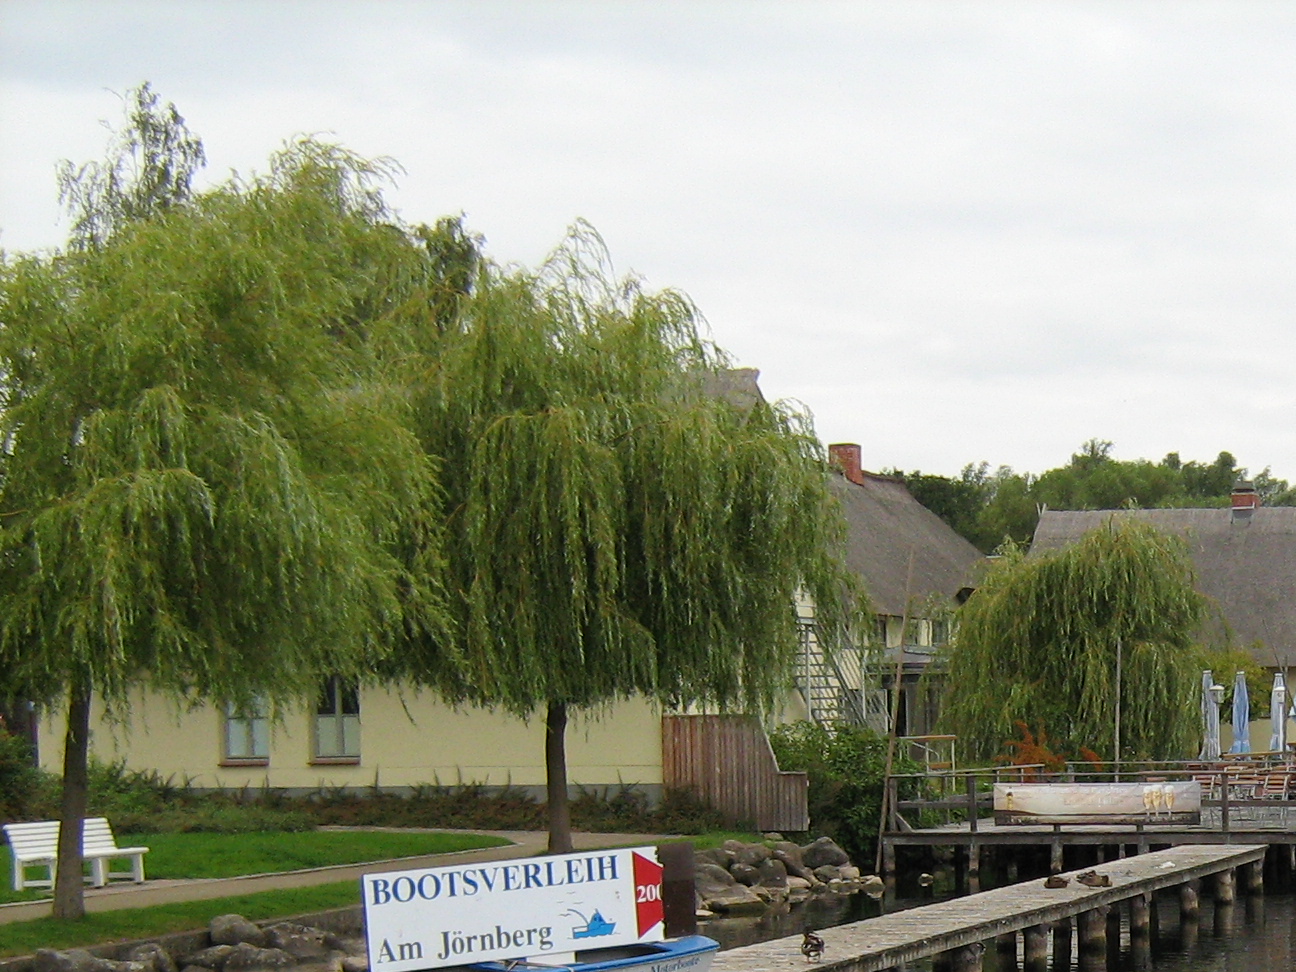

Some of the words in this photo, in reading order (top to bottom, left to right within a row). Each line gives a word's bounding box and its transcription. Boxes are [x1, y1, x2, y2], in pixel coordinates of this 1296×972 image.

[370, 854, 620, 906] BOOTSVERLEIH
[377, 936, 424, 964] Am
[437, 923, 554, 961] Jörnberg
